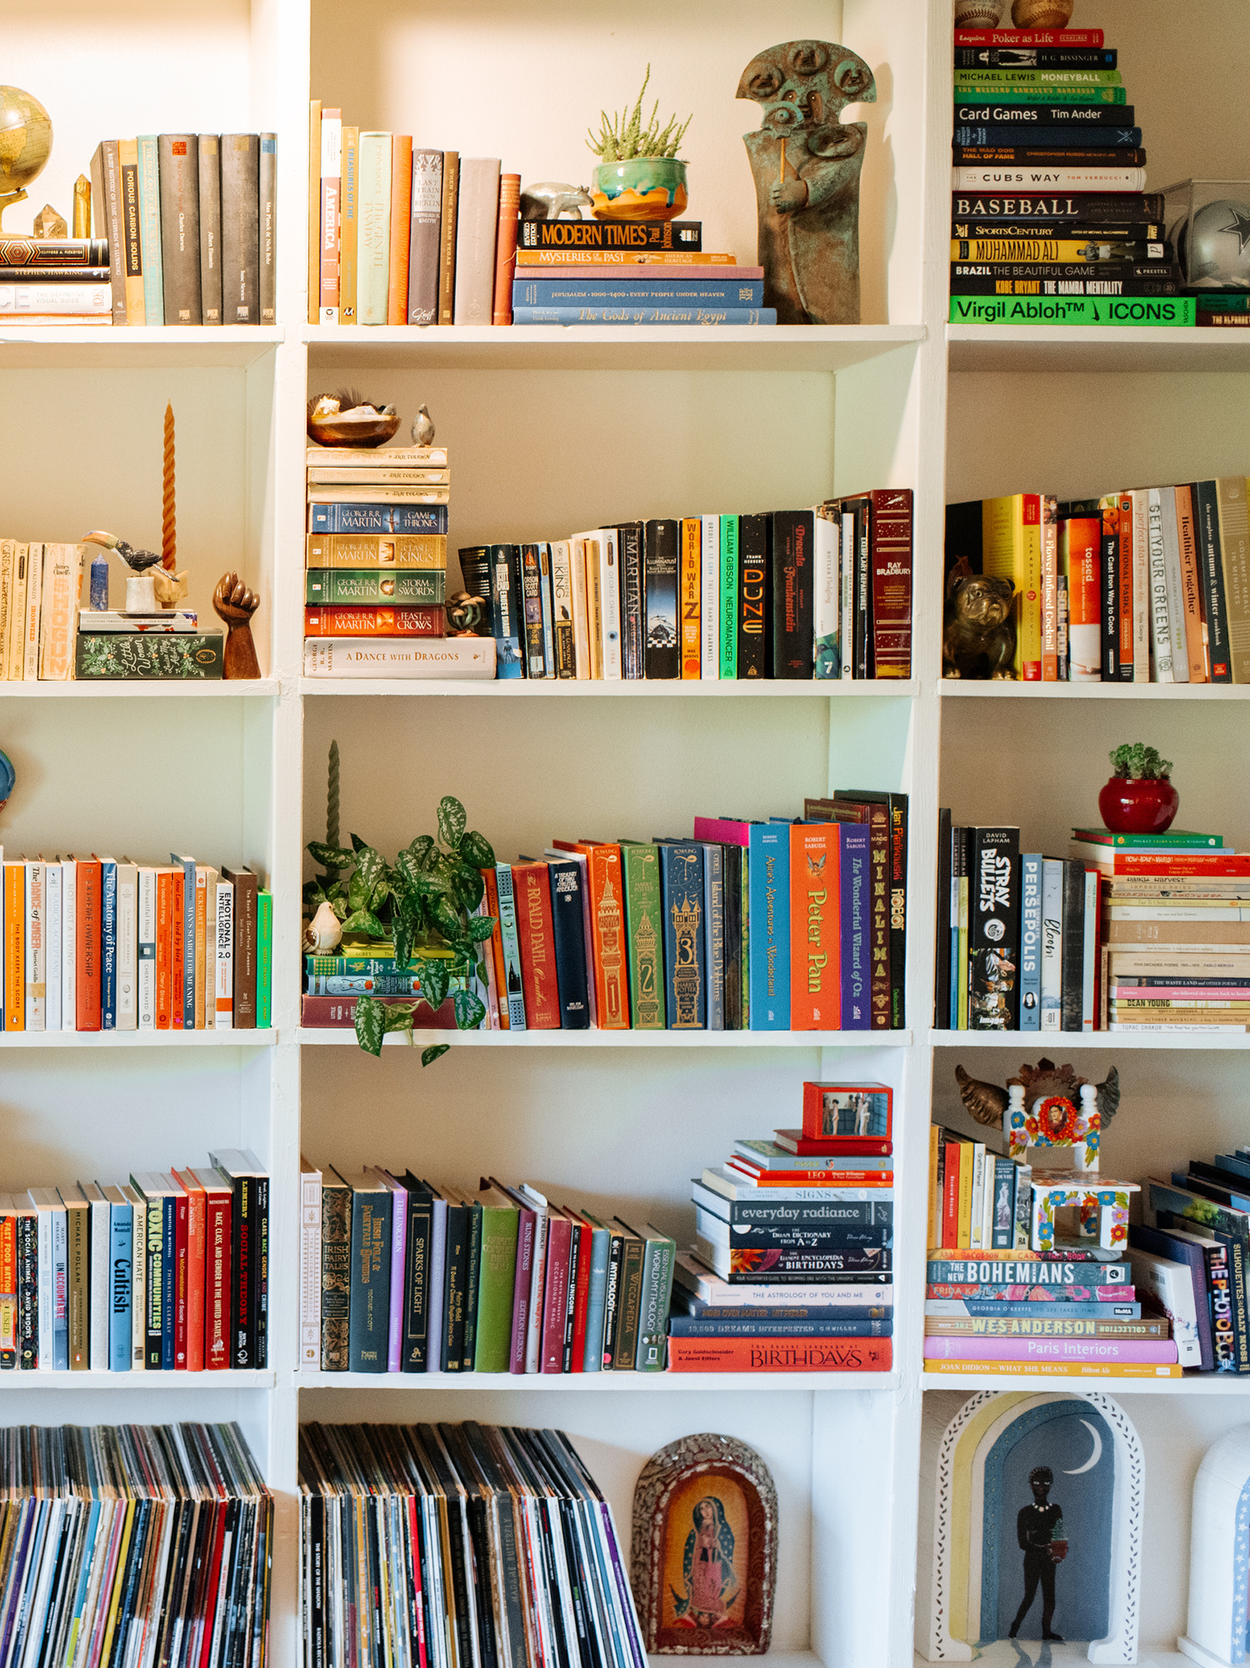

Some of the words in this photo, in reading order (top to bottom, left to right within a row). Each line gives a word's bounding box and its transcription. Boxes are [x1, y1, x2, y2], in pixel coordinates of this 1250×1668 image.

[959, 108, 989, 120] Card
[993, 108, 1037, 120] Games
[1051, 109, 1069, 119] Tim
[1071, 109, 1101, 119] Ander
[983, 174, 1024, 182] CUBS
[1031, 174, 1060, 182] WAY
[325, 186, 337, 250] AMERICA
[957, 200, 1079, 215] BASEBALL
[542, 225, 602, 245] MODERN
[605, 225, 647, 245] TIMES
[976, 240, 1039, 261] MUHAMMAD
[1041, 241, 1058, 260] ALI
[956, 267, 991, 275] BRAZIL
[993, 267, 1010, 275] THE
[1013, 267, 1062, 275] BEAUTIFUL
[1065, 267, 1095, 275] GAME
[579, 310, 597, 321] The
[602, 310, 629, 321] Gods
[634, 310, 645, 321] of
[650, 310, 691, 321] Ancient
[696, 311, 726, 325] Egypt
[957, 301, 1006, 322] Virgil
[1010, 301, 1085, 319] Abloh™
[1109, 304, 1176, 320] ICONS
[1085, 548, 1094, 581] tossed
[627, 542, 639, 614] MARTIAN
[1106, 590, 1114, 604] Way
[1108, 606, 1114, 614] to
[725, 596, 733, 661] NEUROMANCER
[852, 858, 862, 874] The
[979, 848, 998, 912] BULLETS
[995, 856, 1011, 907] STRAY
[527, 888, 545, 929] ROALD
[852, 875, 862, 930] Wonderful
[891, 889, 904, 930] ROBOT
[808, 887, 828, 947] Peter
[1024, 862, 1037, 972] PERSEPOLIS
[531, 933, 545, 966] DAHL
[853, 933, 862, 969] Wizard
[808, 950, 828, 994] Pan
[851, 970, 862, 980] of
[853, 982, 861, 997] Oz
[742, 1208, 800, 1220] everyday
[803, 1207, 859, 1218] radiance
[148, 1201, 162, 1251] TOXIC
[415, 1238, 424, 1271] SPARKS
[652, 1249, 661, 1279] WORLD
[786, 1261, 844, 1269] BIRTHDAYS
[114, 1259, 130, 1313] Cultish
[415, 1272, 422, 1284] OF
[153, 1253, 161, 1329] COMMUNITIES
[414, 1287, 422, 1314] LIGHT
[647, 1281, 659, 1332] MYTHOLOGY
[972, 1320, 1007, 1332] WES
[1011, 1320, 1096, 1334] ANDERSON
[751, 1350, 862, 1367] BIRTHDAYS
[1028, 1342, 1059, 1354] Paris
[1065, 1343, 1119, 1355] Interiors
